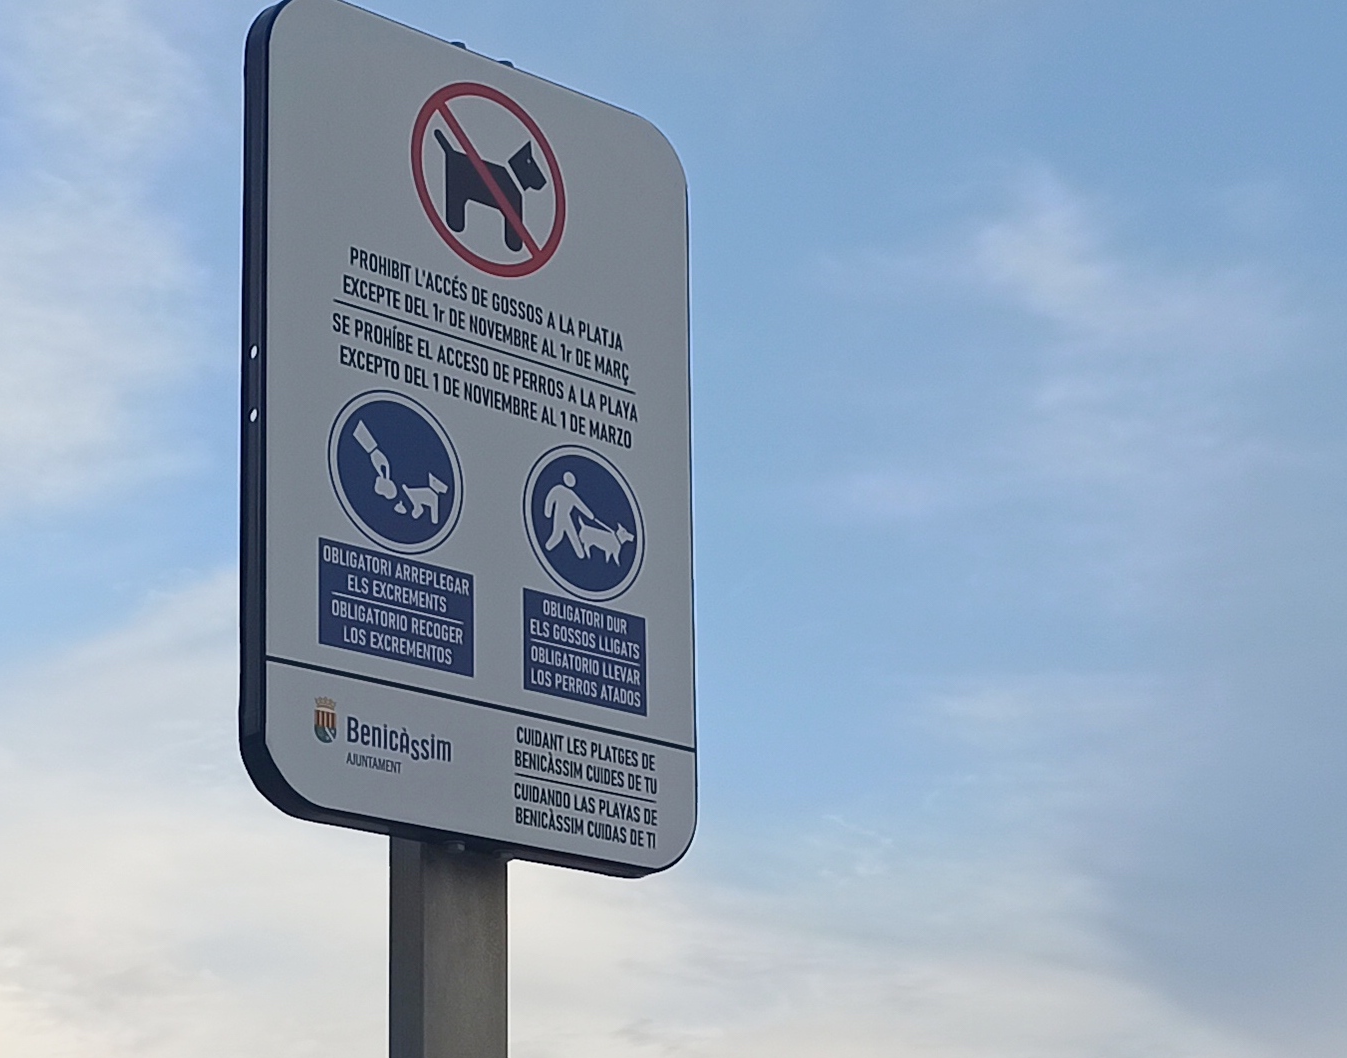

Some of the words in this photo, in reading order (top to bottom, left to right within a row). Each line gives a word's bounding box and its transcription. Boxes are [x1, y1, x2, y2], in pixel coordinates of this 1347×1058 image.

[350, 247, 411, 282] PROHIBIT
[416, 268, 467, 300] L'ACCÉS
[472, 286, 488, 308] DE
[492, 293, 542, 325] GOSSOS
[547, 311, 555, 330] A
[560, 314, 574, 336] LA
[579, 321, 623, 351] PLATJA
[344, 275, 400, 310] EXCEPTE
[405, 294, 428, 318] DEL
[433, 303, 445, 322] 1r
[450, 308, 465, 329] DE
[470, 315, 537, 352] NOVEMBRE
[542, 338, 557, 358] AL
[561, 344, 572, 362] 1r
[576, 348, 591, 369] DE
[595, 354, 629, 386] MARÇ
[333, 313, 350, 335] SE
[355, 319, 413, 354] PROHÍBE
[418, 338, 433, 360] EL
[437, 345, 488, 376] ACCESO
[494, 361, 509, 383] DE
[514, 368, 564, 399] PERROS
[568, 385, 576, 403] A
[581, 388, 595, 409] LA
[600, 394, 638, 422] PLAYA
[340, 345, 399, 380] EXCEPTO
[405, 364, 428, 388] DEL
[433, 373, 438, 391] 1
[444, 376, 459, 397] DE
[465, 382, 537, 420] NOVIEMBRE
[542, 406, 557, 427] AL
[561, 411, 565, 429] 1
[570, 414, 585, 435] DE
[590, 420, 631, 448] MARZO
[324, 545, 391, 576] OBLIGATORI
[395, 563, 469, 596] ARREPLEGAR
[348, 575, 368, 594] ELS
[373, 580, 446, 613] EXCREMENTS
[332, 599, 407, 631] OBLIGATORIO
[412, 618, 463, 645] RECOGER
[543, 600, 604, 629] OBLIGATORI
[607, 615, 627, 634] DUR
[344, 626, 366, 645] LOS
[370, 632, 452, 664] EXCREMENTOS
[530, 619, 549, 637] ELS
[554, 624, 595, 648] GOSSOS
[599, 635, 639, 659] LLIGATS
[531, 646, 599, 675] OBLIGATORIO
[603, 662, 640, 685] LLEVAR
[531, 668, 551, 687] LOS
[555, 674, 597, 697] PERROS
[601, 684, 640, 707] ATADOS
[346, 753, 401, 773] AJUNTAMENT
[517, 727, 563, 751] CUIDANT
[567, 737, 587, 756] LES
[591, 742, 638, 767] PLATGES
[642, 753, 655, 771] DE
[515, 750, 582, 779] BENICÀSSIM
[587, 765, 624, 787] CUIDES
[628, 773, 641, 791] DE
[645, 777, 657, 794] TU
[515, 783, 570, 808] CUIDANDO
[575, 794, 595, 813] LAS
[599, 799, 640, 823] PLAYAS
[644, 808, 657, 826] DE
[516, 807, 583, 835] BENICÀSSIM
[588, 821, 626, 843] CUIDAS
[630, 829, 644, 846] DE
[647, 832, 656, 849] TI
